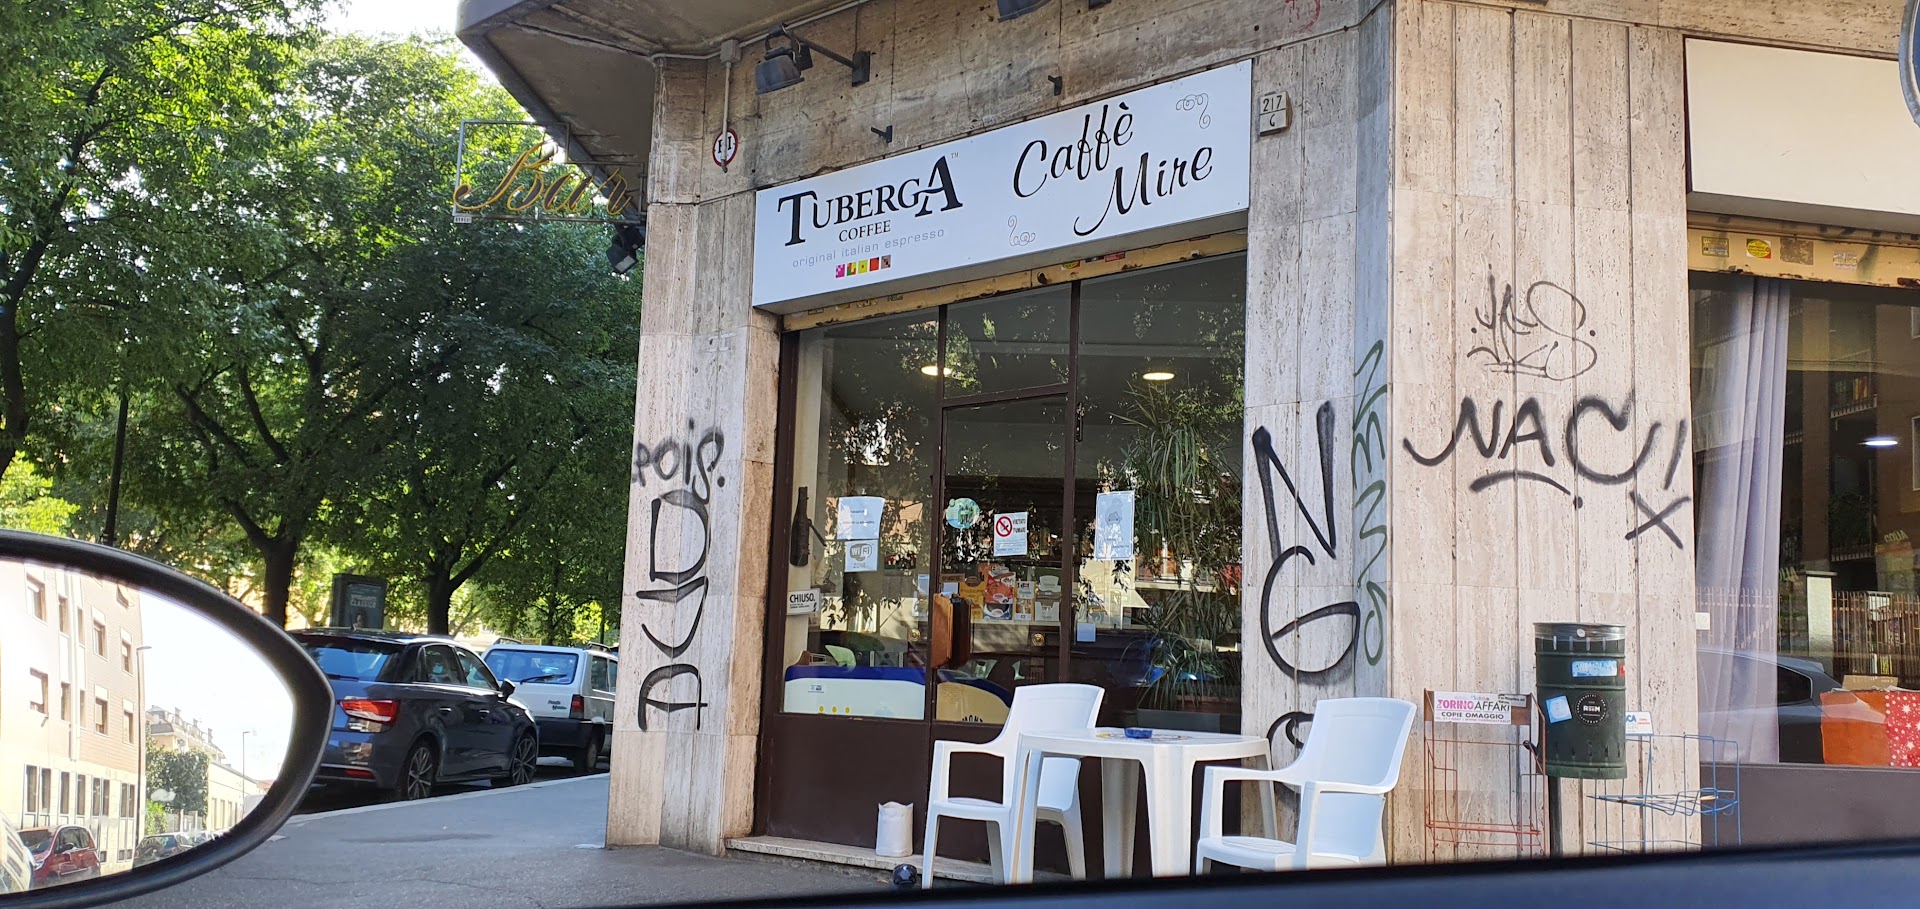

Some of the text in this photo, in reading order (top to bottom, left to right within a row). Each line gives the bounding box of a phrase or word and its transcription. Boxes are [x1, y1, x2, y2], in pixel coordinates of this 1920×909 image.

[1263, 95, 1283, 112] 217
[1012, 101, 1134, 198] Caffè
[453, 141, 632, 216] Bar
[777, 155, 963, 247] TUBERGA
[1073, 147, 1213, 236] Mire
[792, 228, 945, 268] original italian espresso
[838, 219, 892, 243] COFFEE
[1441, 711, 1463, 719] COPIE
